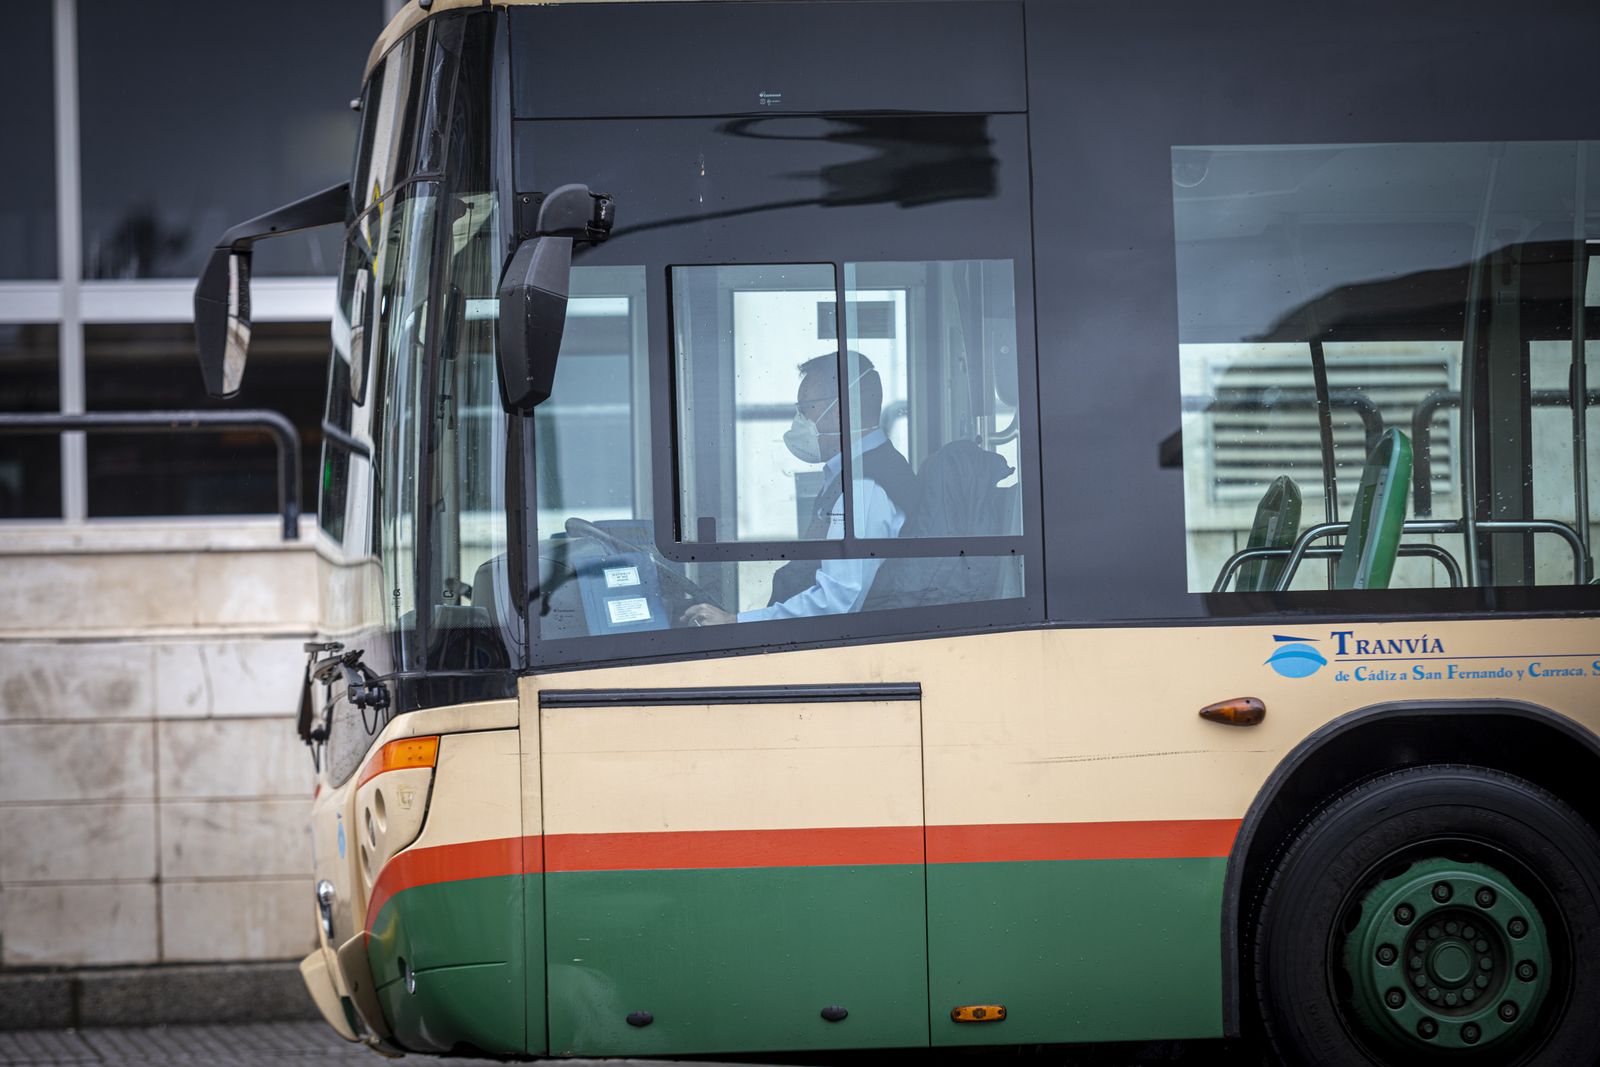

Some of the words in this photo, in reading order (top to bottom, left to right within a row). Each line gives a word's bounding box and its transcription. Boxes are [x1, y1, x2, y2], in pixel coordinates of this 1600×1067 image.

[1330, 631, 1444, 655] TRANVÍA
[1335, 671, 1350, 682] de
[1354, 666, 1396, 682] Cádiz
[1412, 664, 1442, 680] San
[1447, 664, 1513, 680] Fernando
[1516, 669, 1525, 681] y
